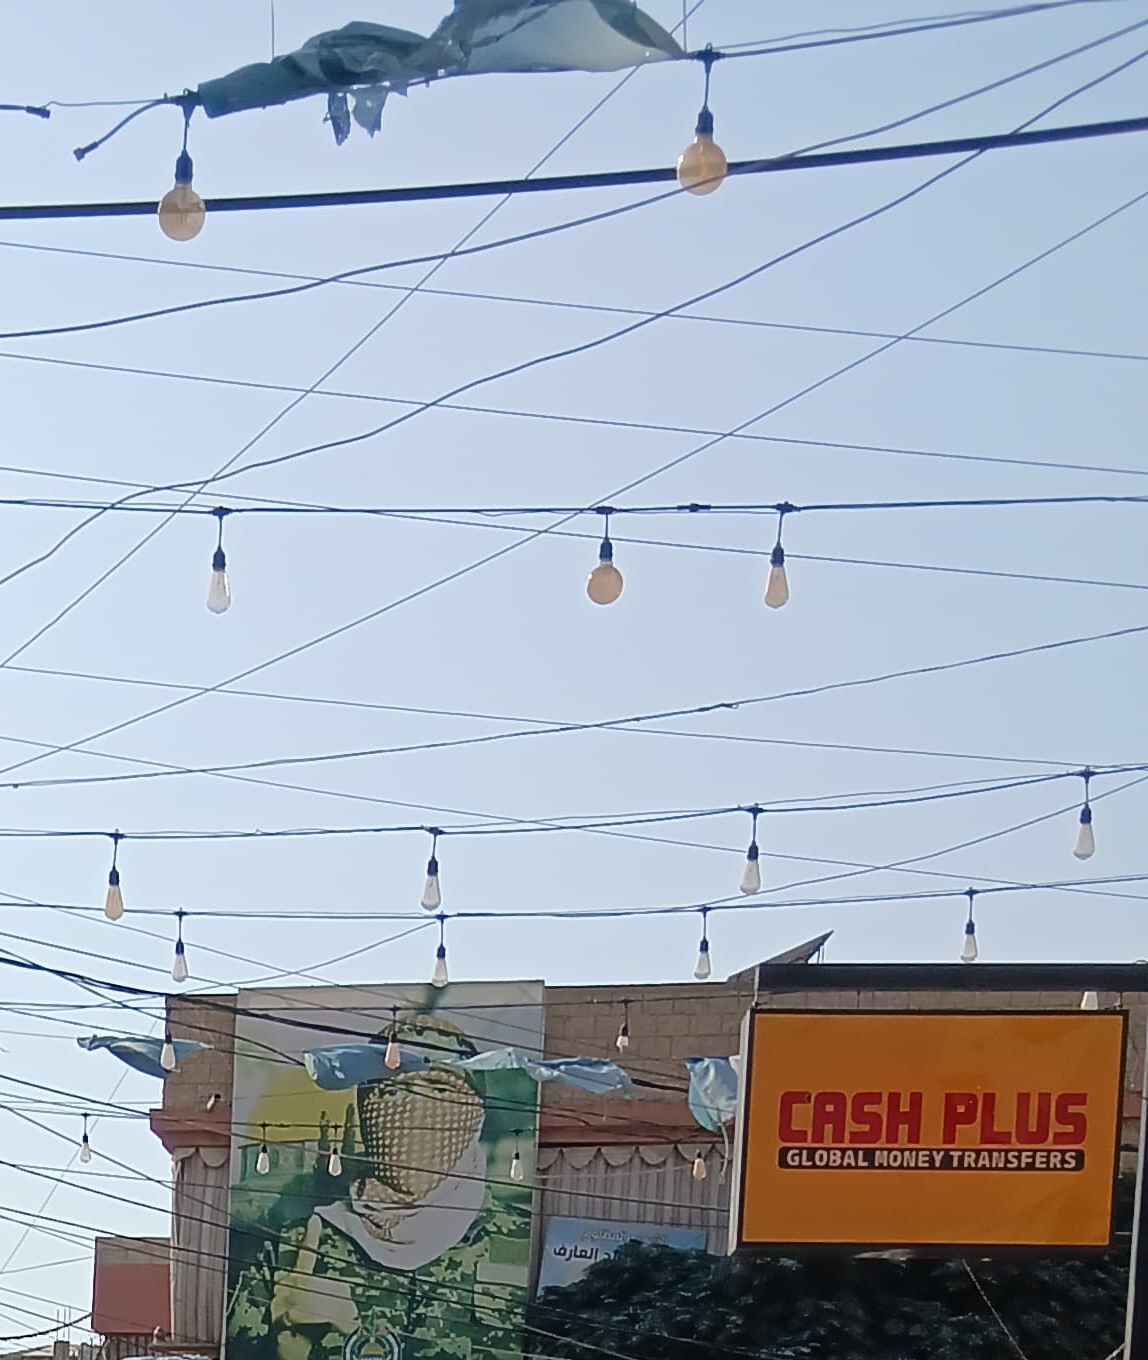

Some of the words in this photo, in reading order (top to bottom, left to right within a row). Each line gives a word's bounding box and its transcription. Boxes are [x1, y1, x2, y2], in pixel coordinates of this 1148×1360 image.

[778, 1091, 923, 1144] CASH
[942, 1092, 1088, 1145] PLUS
[786, 1149, 869, 1167] GLOBAL
[874, 1150, 944, 1168] MONEY
[950, 1151, 1077, 1169] TRANSFERS
[553, 1243, 600, 1263] العارف
